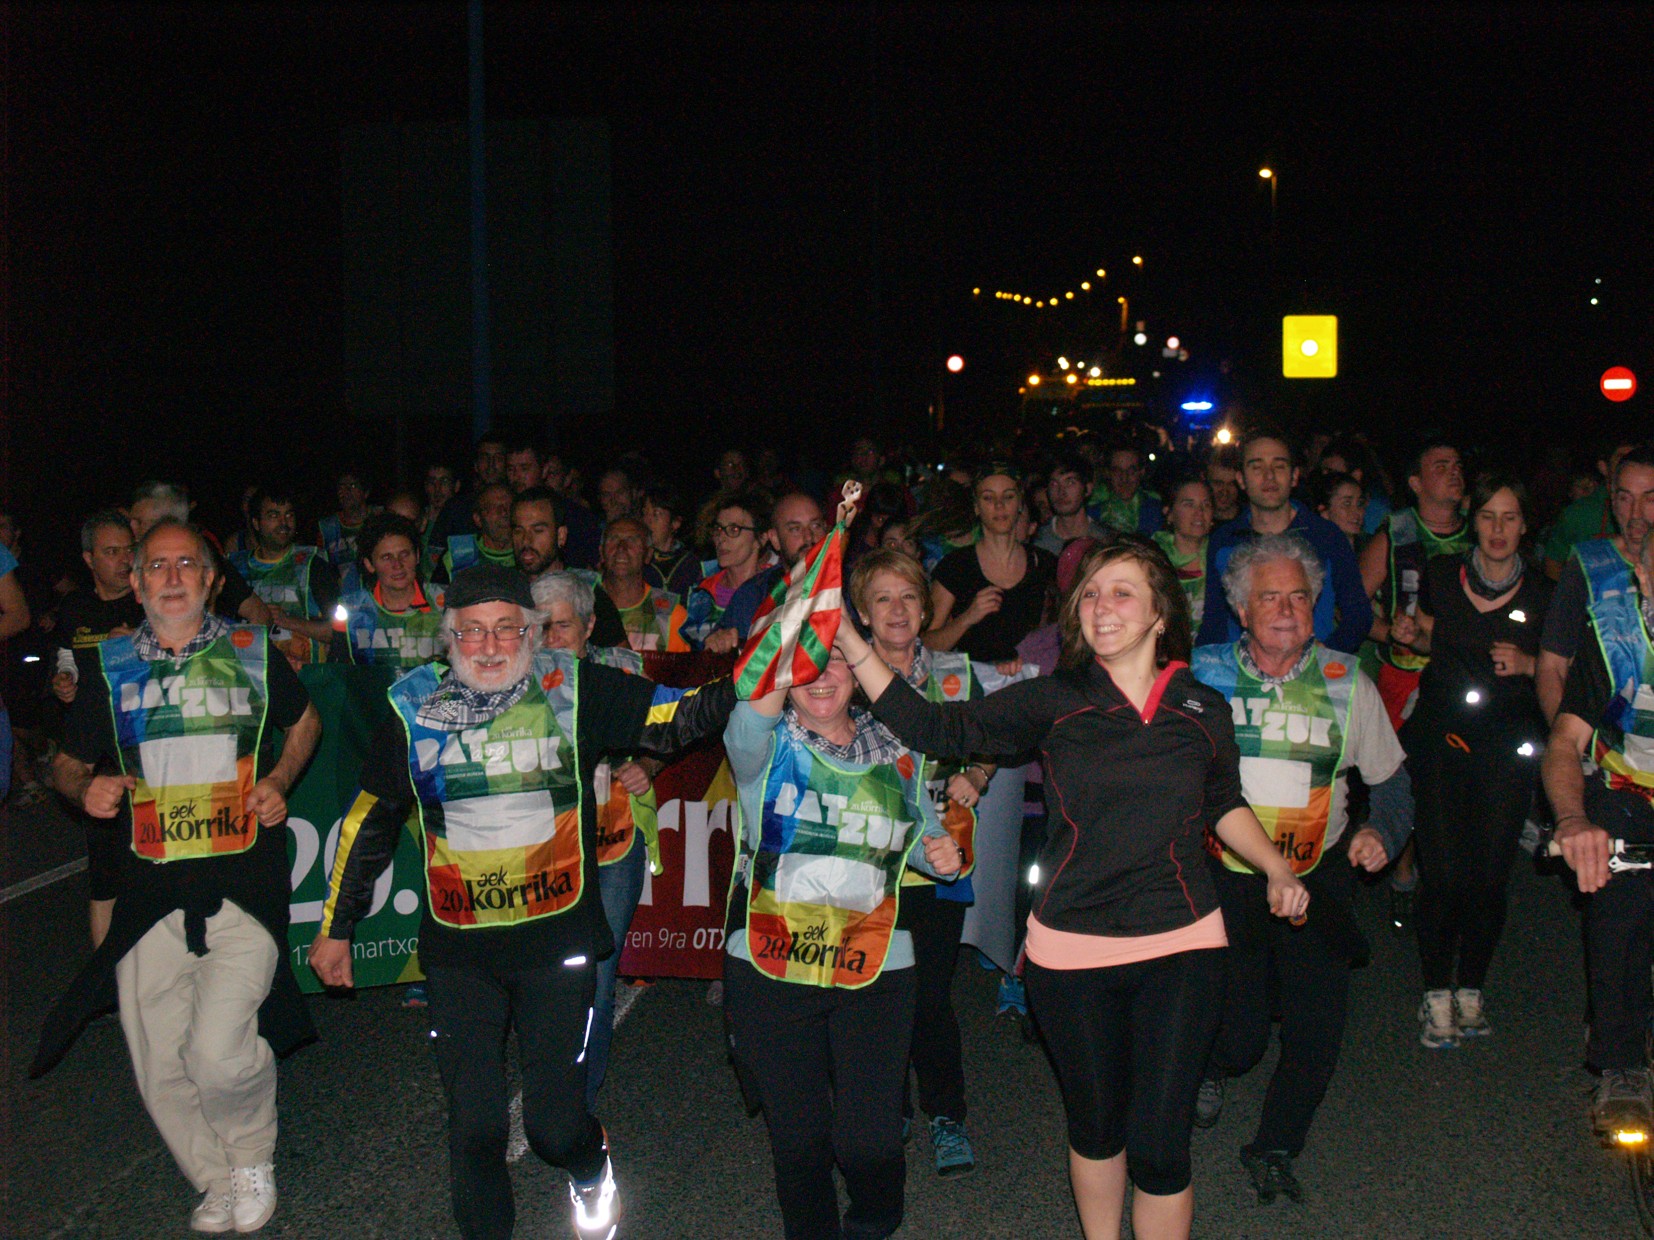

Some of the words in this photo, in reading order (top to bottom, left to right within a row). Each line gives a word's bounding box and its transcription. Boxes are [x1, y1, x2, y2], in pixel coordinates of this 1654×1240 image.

[181, 687, 253, 719] ZUK
[1229, 696, 1271, 726] AT
[1261, 710, 1333, 748] ZUK
[414, 728, 489, 773] BAT
[484, 736, 563, 777] ZUK
[773, 781, 849, 827] BAT
[658, 927, 687, 949] 9ra
